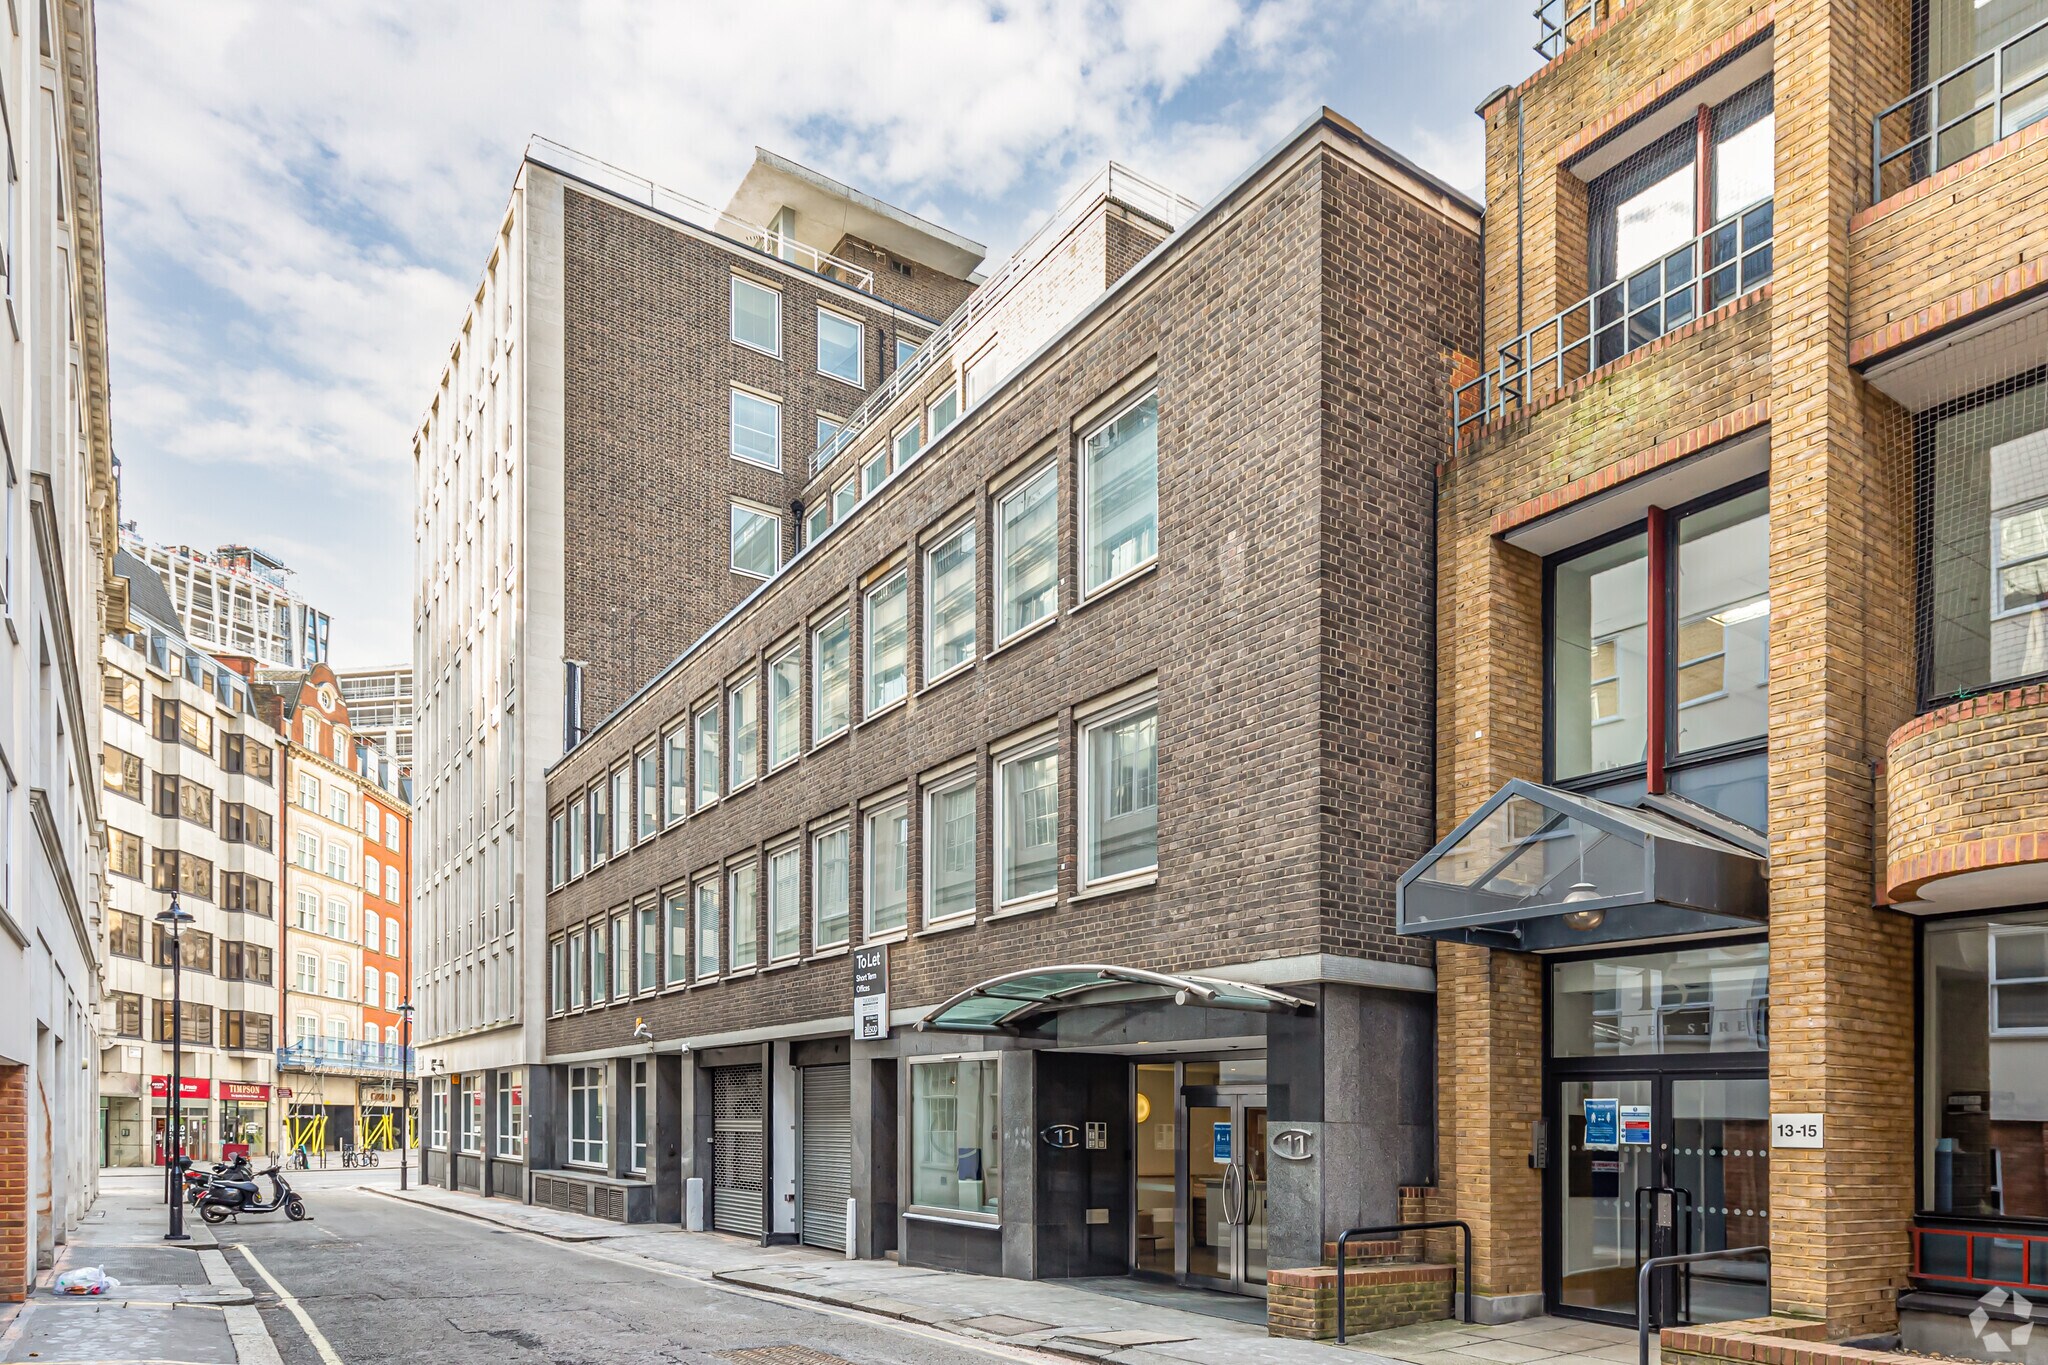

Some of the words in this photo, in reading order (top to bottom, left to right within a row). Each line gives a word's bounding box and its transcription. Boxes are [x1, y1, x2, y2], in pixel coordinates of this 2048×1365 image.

[856, 954, 867, 969] To
[867, 952, 880, 967] Let
[856, 974, 867, 982] Short
[229, 1084, 260, 1094] TIMPSON
[1054, 1129, 1073, 1144] 11
[1777, 1124, 1817, 1137] 13-15
[1282, 1134, 1305, 1155] 11
